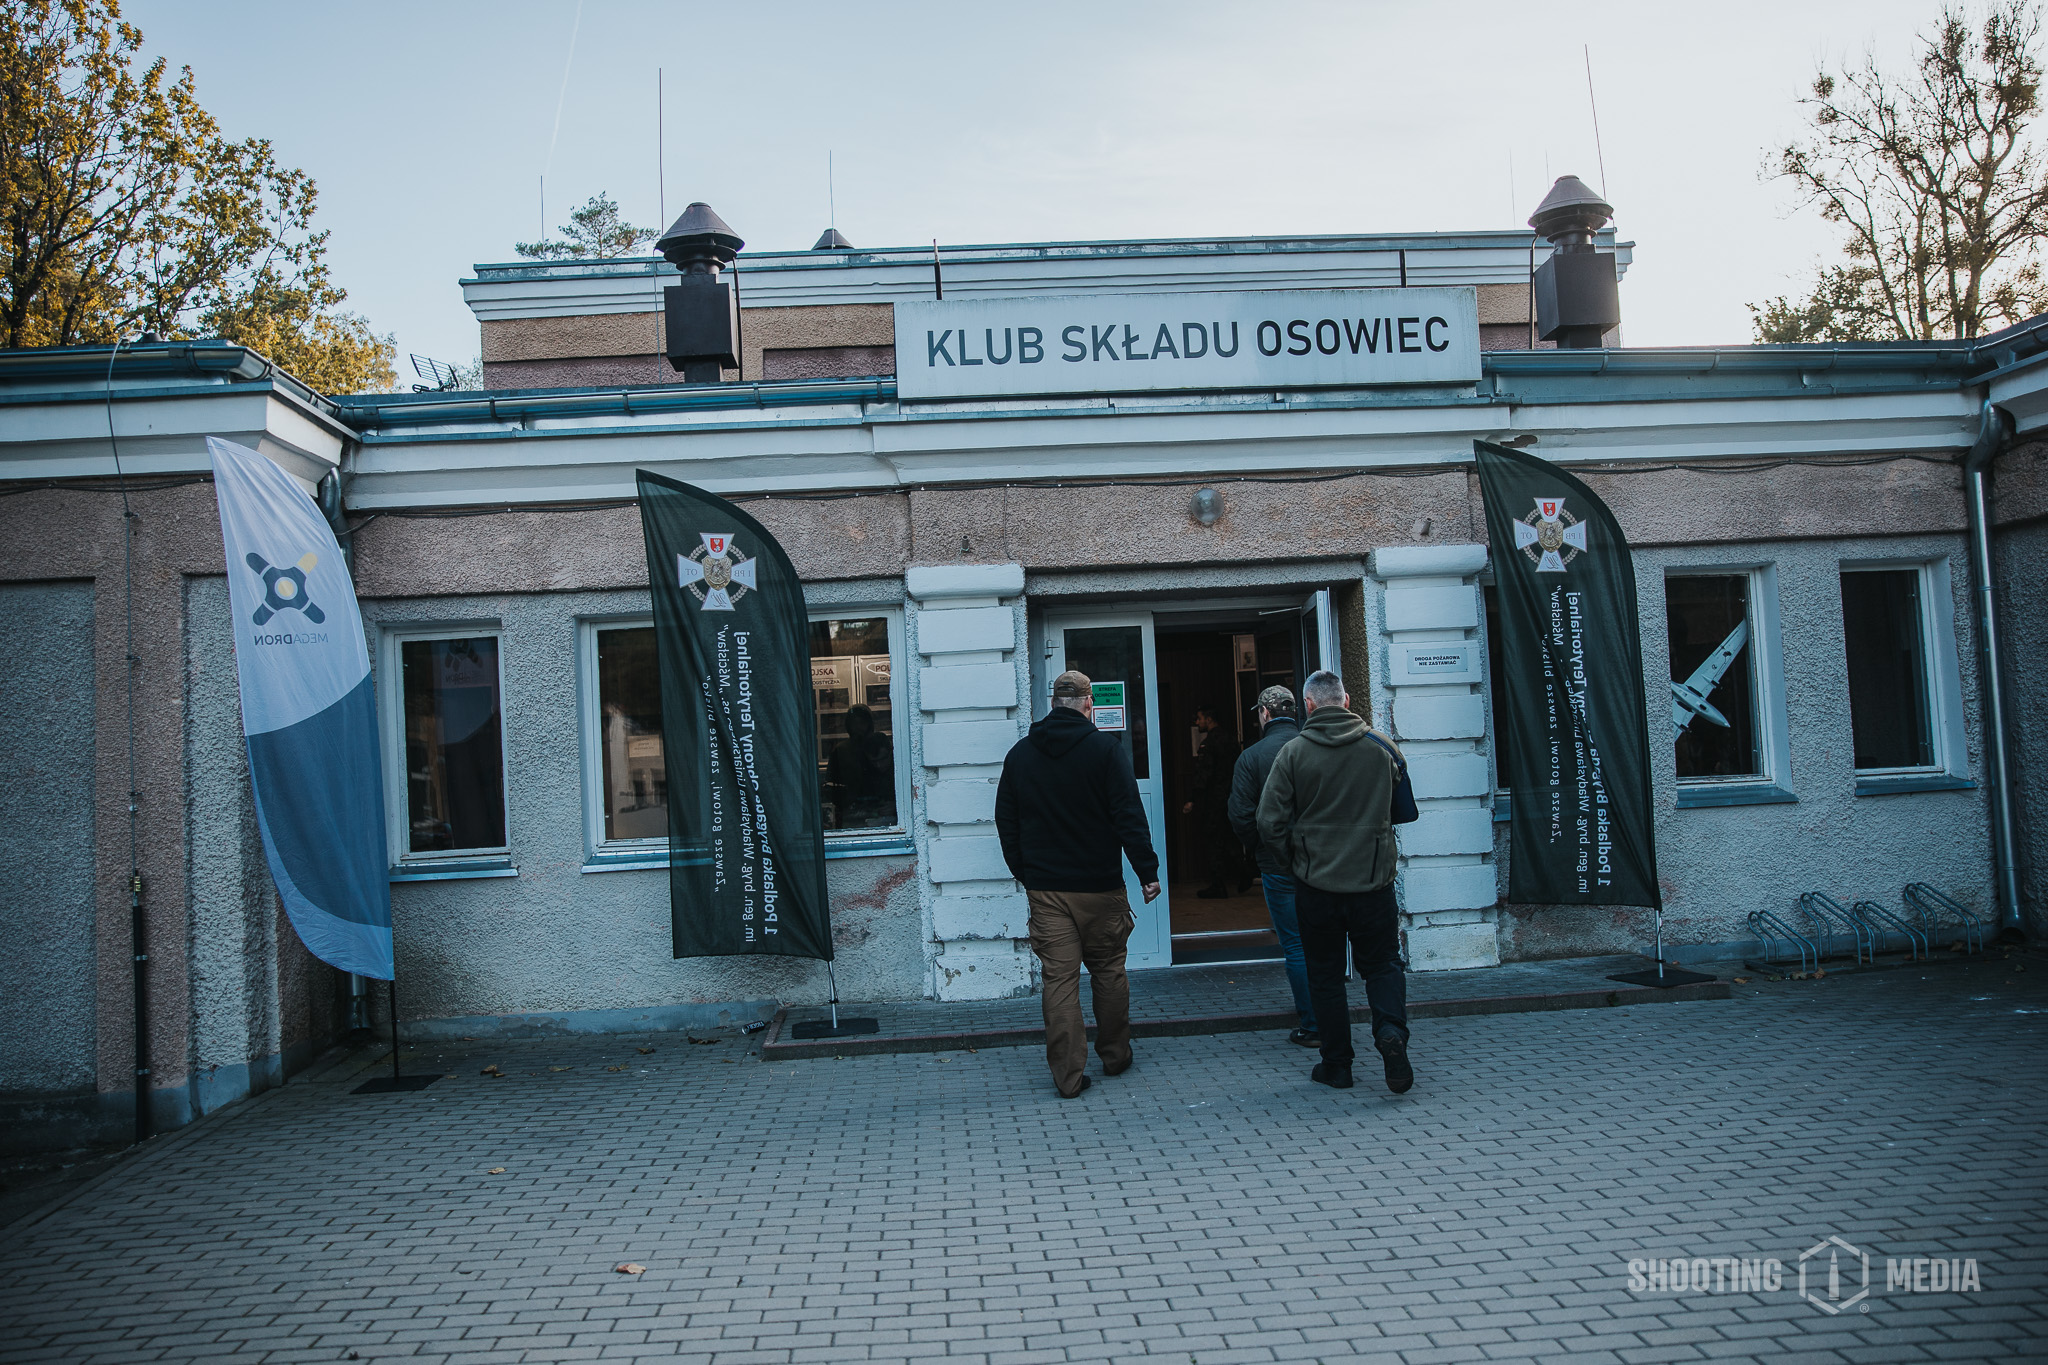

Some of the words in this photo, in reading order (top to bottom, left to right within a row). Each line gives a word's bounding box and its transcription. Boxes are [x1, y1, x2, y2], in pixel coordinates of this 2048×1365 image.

[927, 327, 1045, 368] KLUB
[1061, 321, 1239, 362] SKŁADU
[1256, 316, 1450, 357] OSOWIEC
